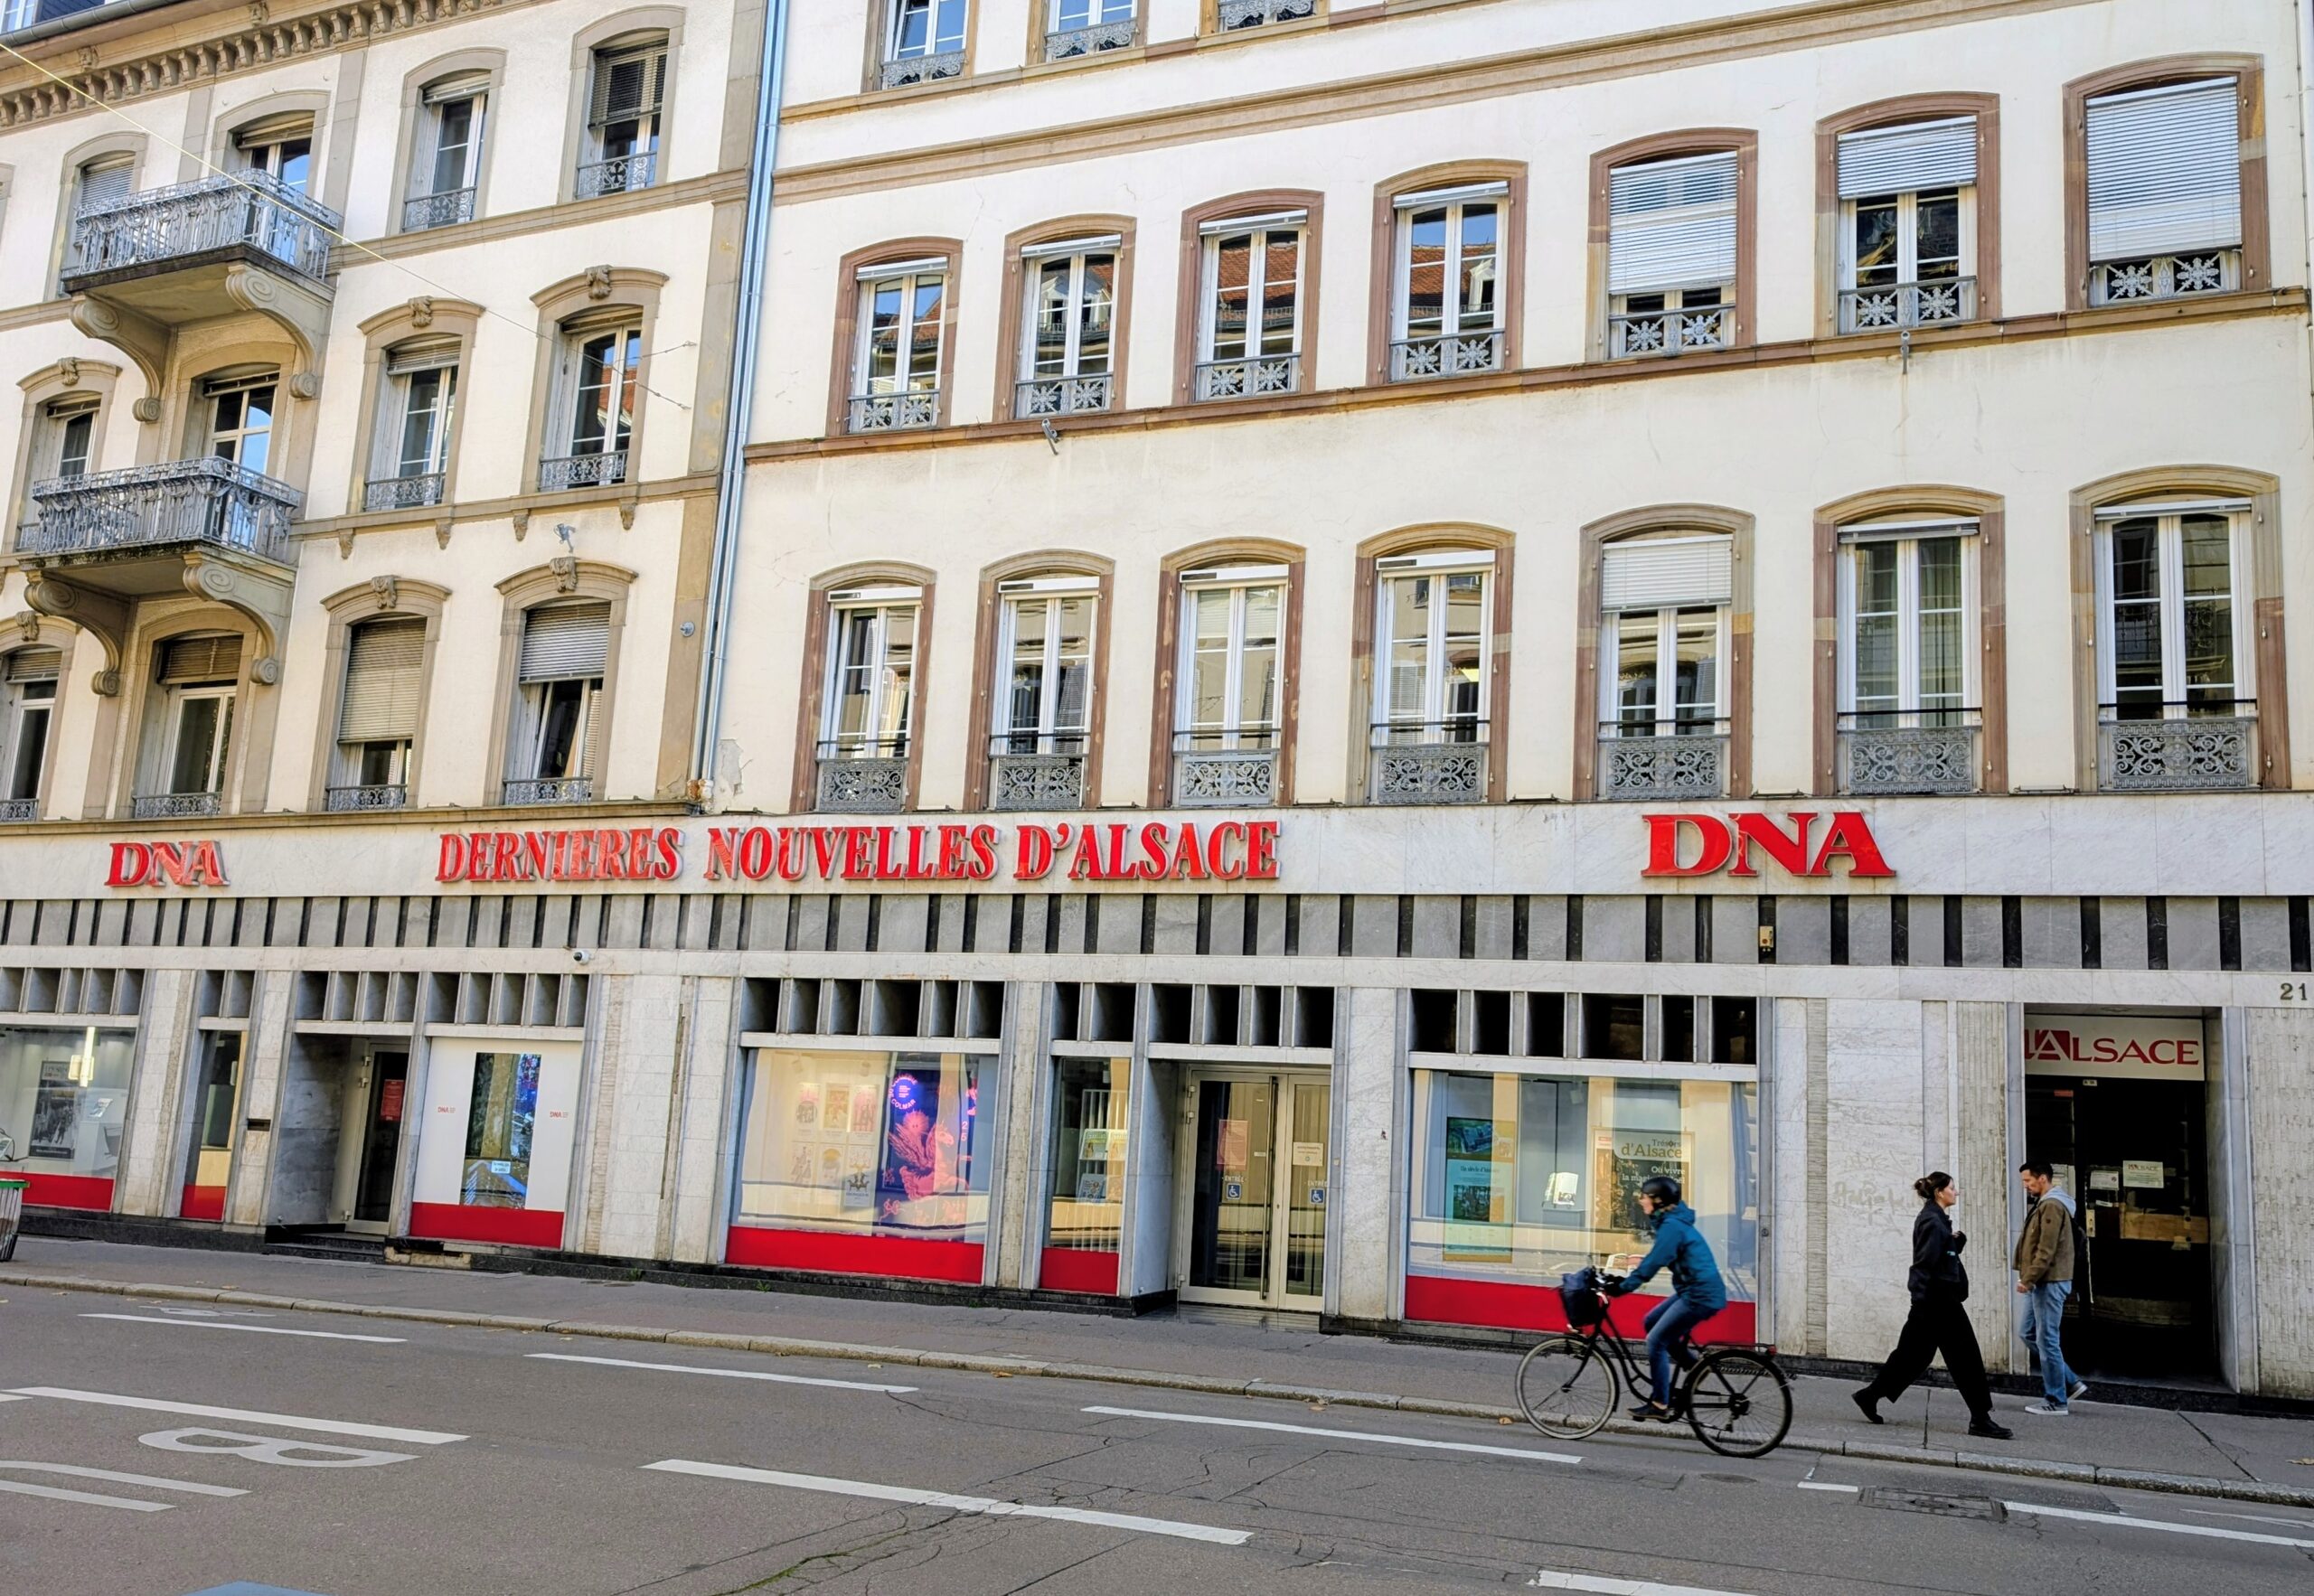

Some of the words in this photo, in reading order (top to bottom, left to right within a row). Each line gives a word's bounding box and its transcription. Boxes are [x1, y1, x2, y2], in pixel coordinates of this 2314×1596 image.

[435, 827, 682, 883] DERNIERES
[704, 824, 997, 882] NOUVELLES
[1013, 820, 1280, 881] D'ALSACE
[1642, 812, 1896, 878] DNA
[106, 840, 226, 887] DNA
[2280, 982, 2308, 1000] 21
[891, 1098, 917, 1110] COLMAR
[1621, 1142, 1682, 1159] d'Alsace
[1225, 1175, 1245, 1183] ENTRÉE
[1622, 1173, 1630, 1181] la
[1664, 1167, 1686, 1175] vivre
